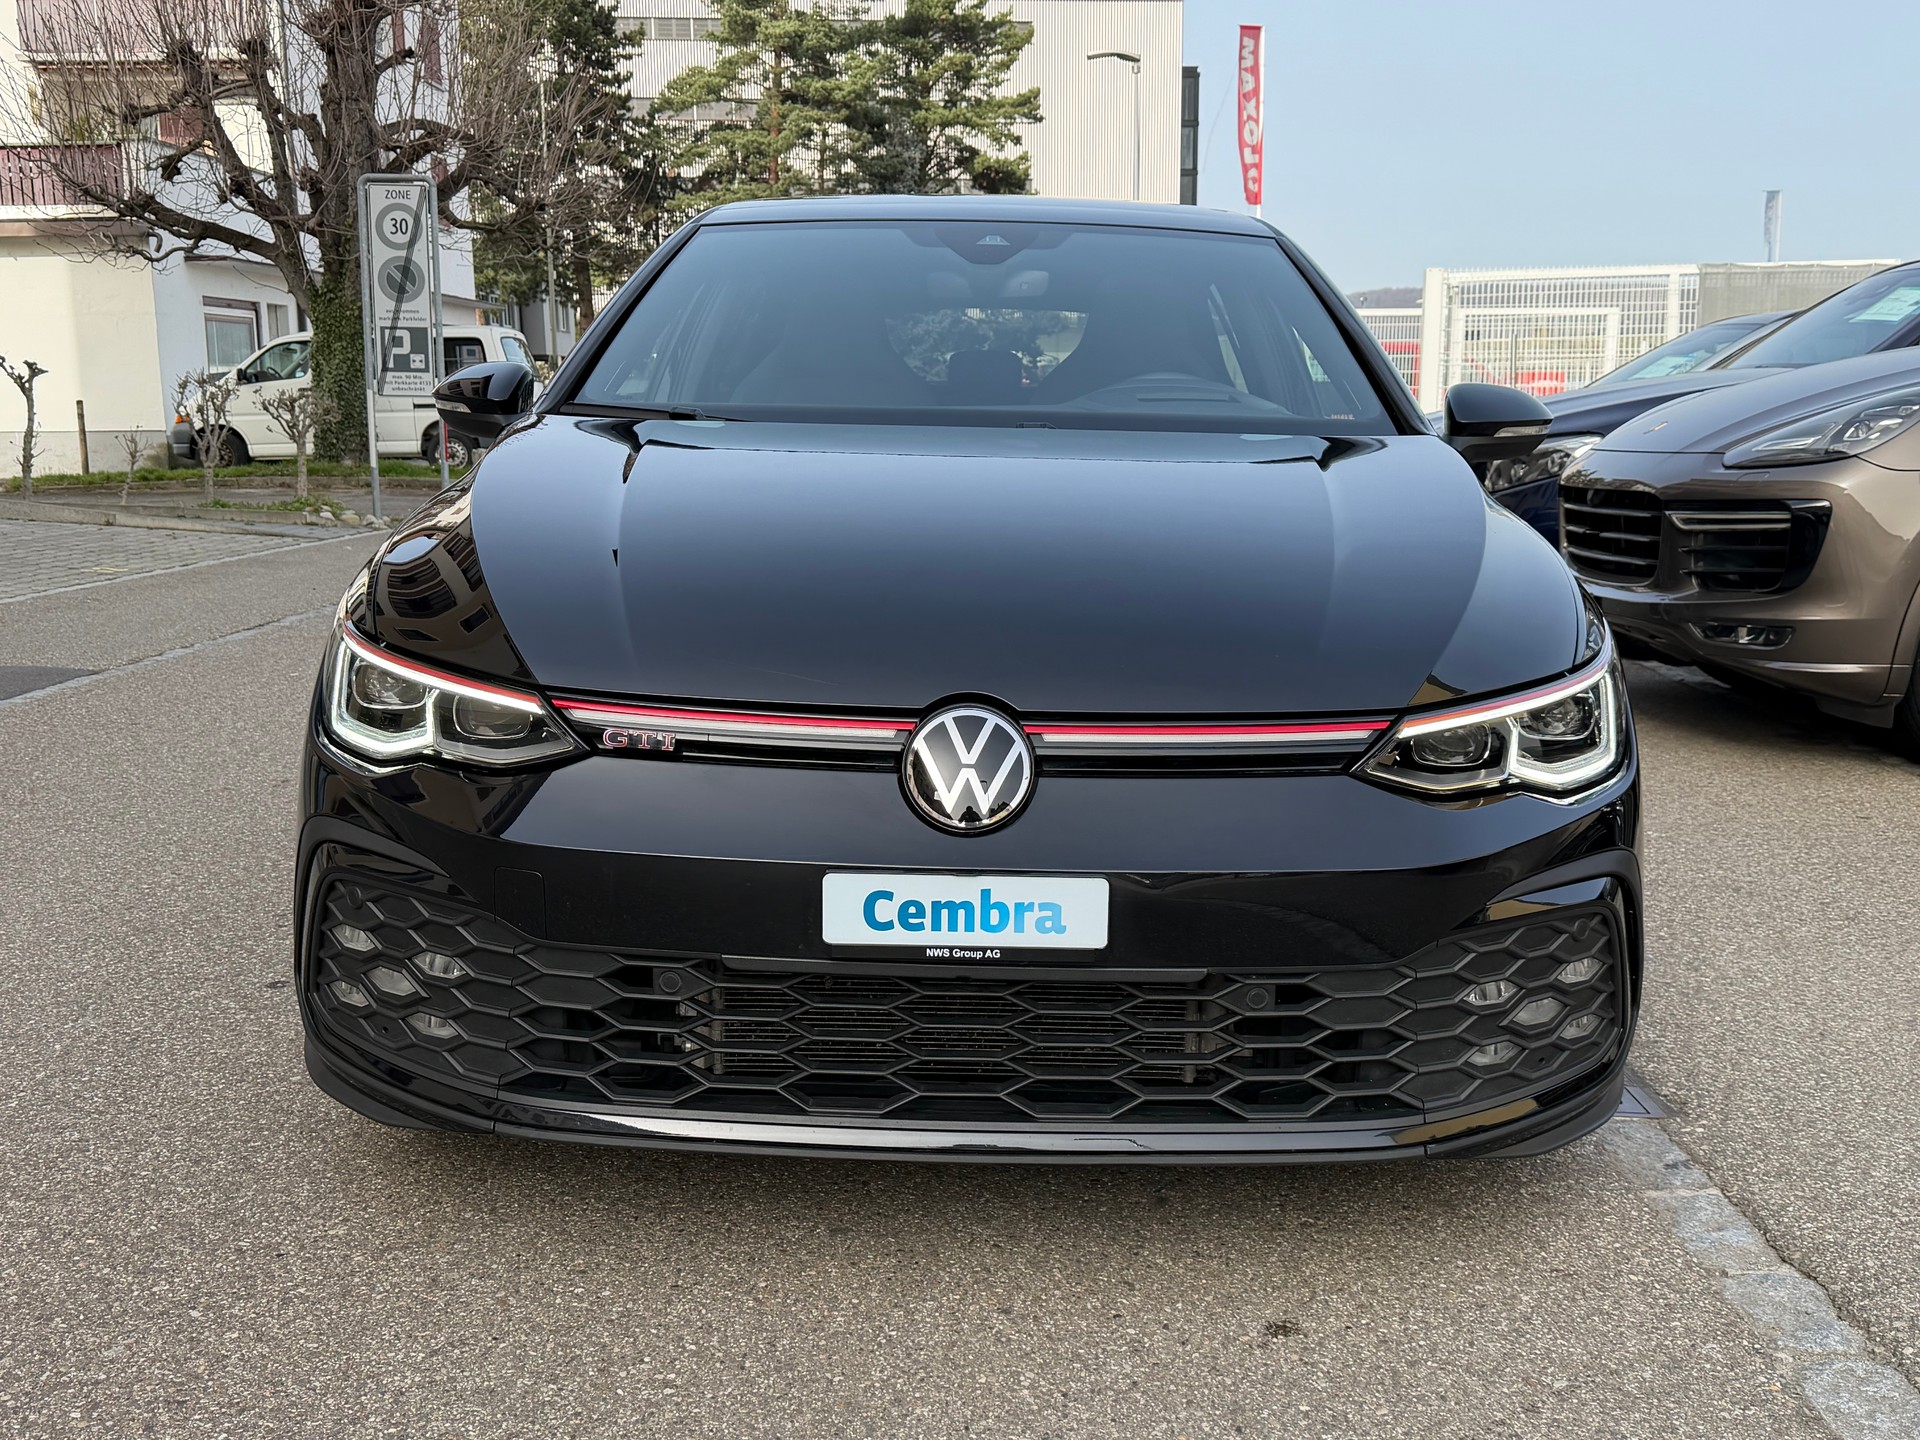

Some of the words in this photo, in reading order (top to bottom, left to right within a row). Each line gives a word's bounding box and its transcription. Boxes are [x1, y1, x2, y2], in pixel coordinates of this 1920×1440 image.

[384, 189, 412, 200] ZONE
[389, 217, 409, 235] 30
[384, 328, 411, 369] P
[602, 728, 676, 751] GTI
[862, 888, 1067, 935] Cembra
[925, 948, 950, 957] NWS
[952, 948, 983, 959] Group
[984, 949, 1001, 958] AG
